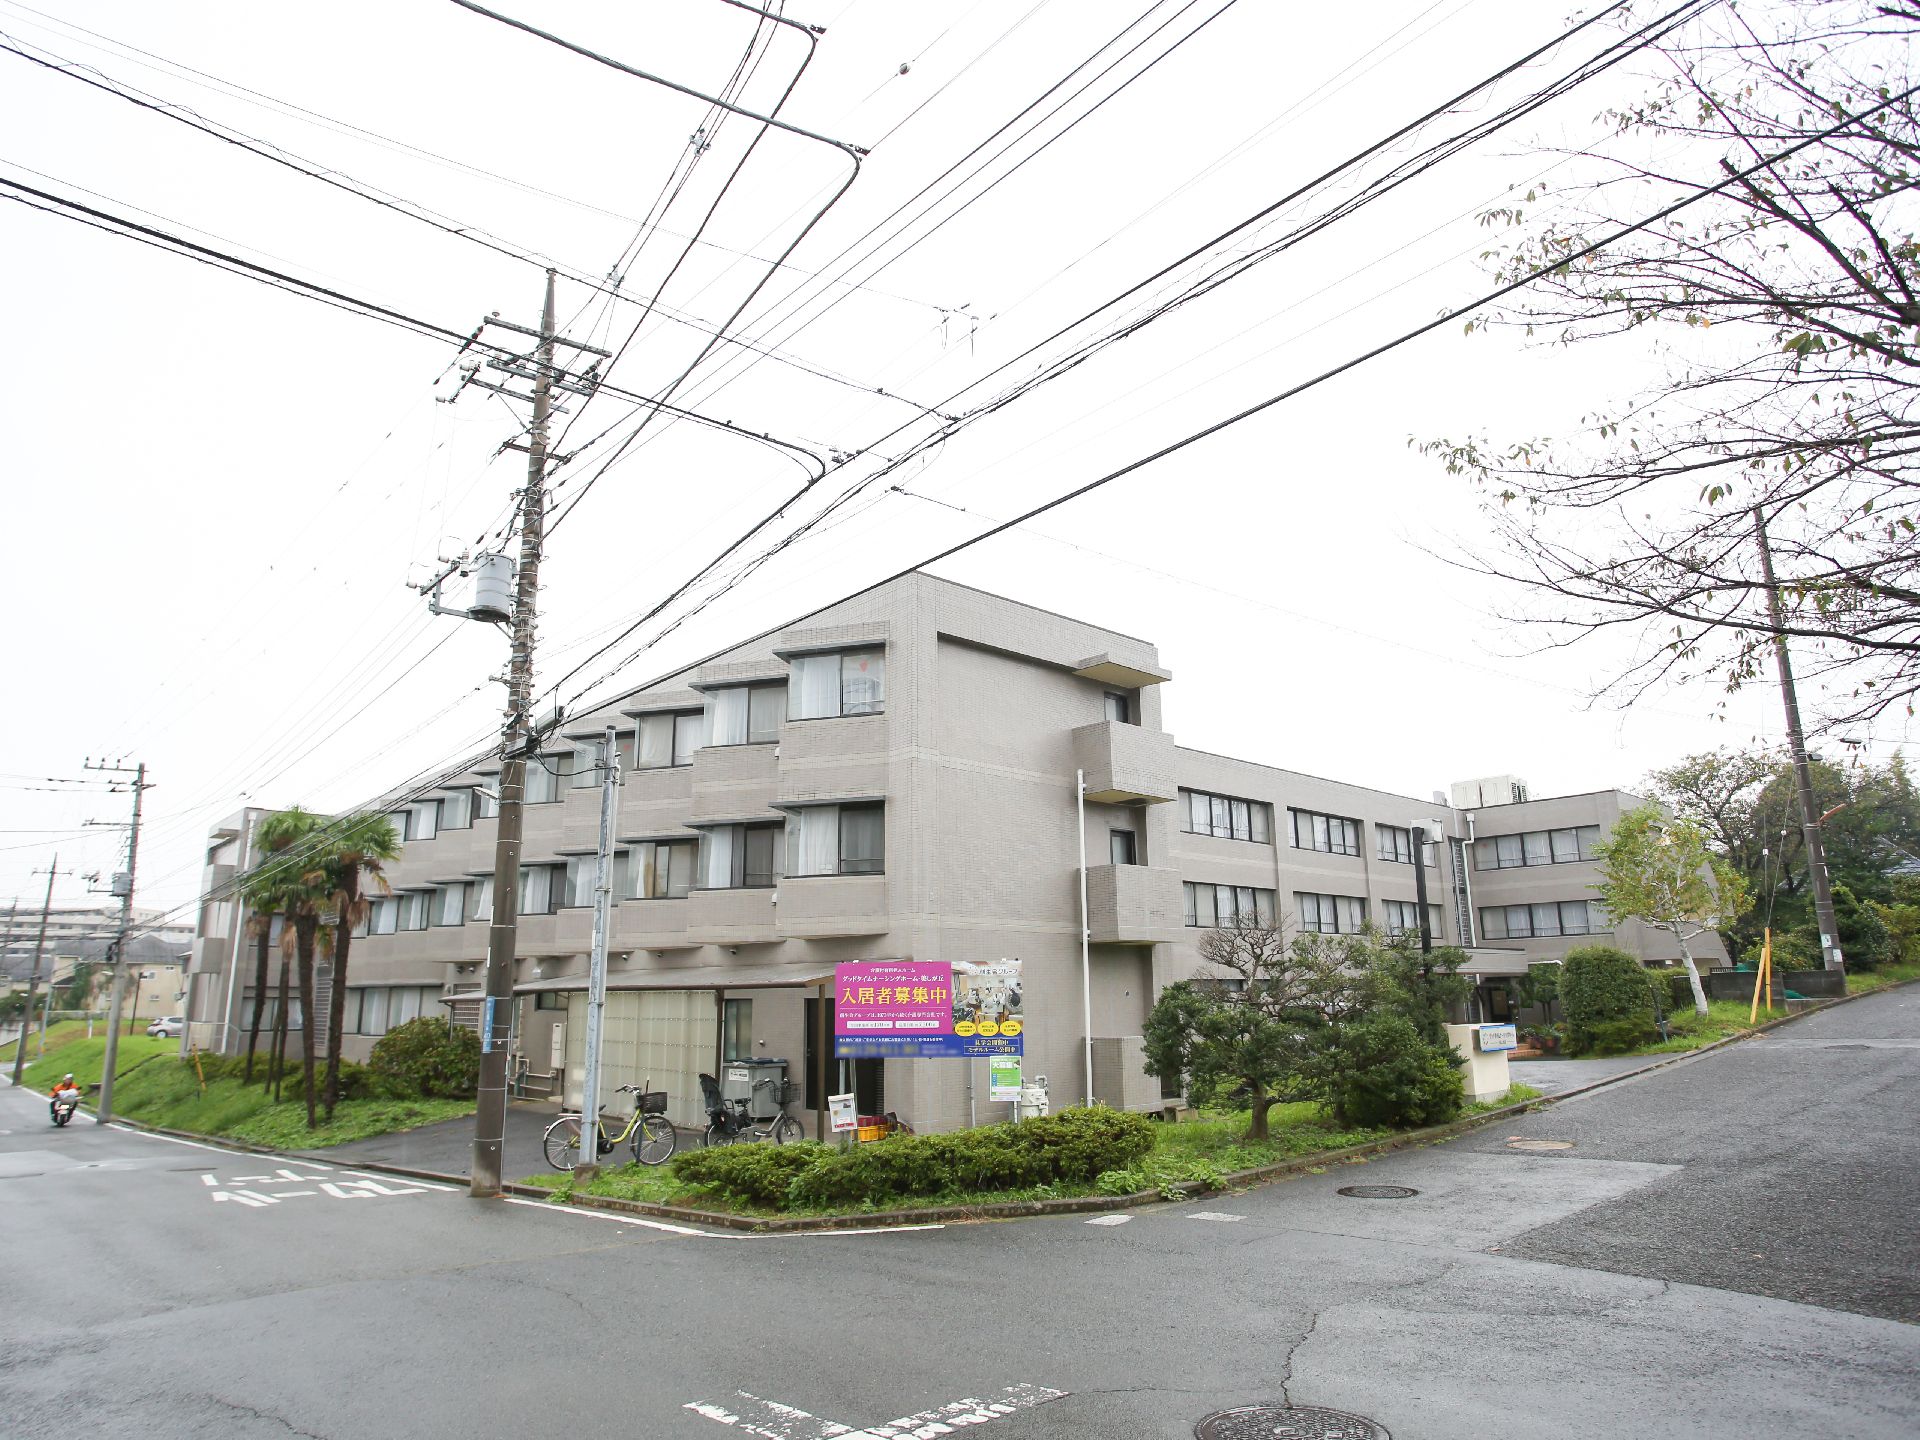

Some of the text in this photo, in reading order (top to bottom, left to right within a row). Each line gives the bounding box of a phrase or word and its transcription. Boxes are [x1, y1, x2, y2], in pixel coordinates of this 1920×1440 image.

[839, 987, 947, 1005] 入居者募集中
